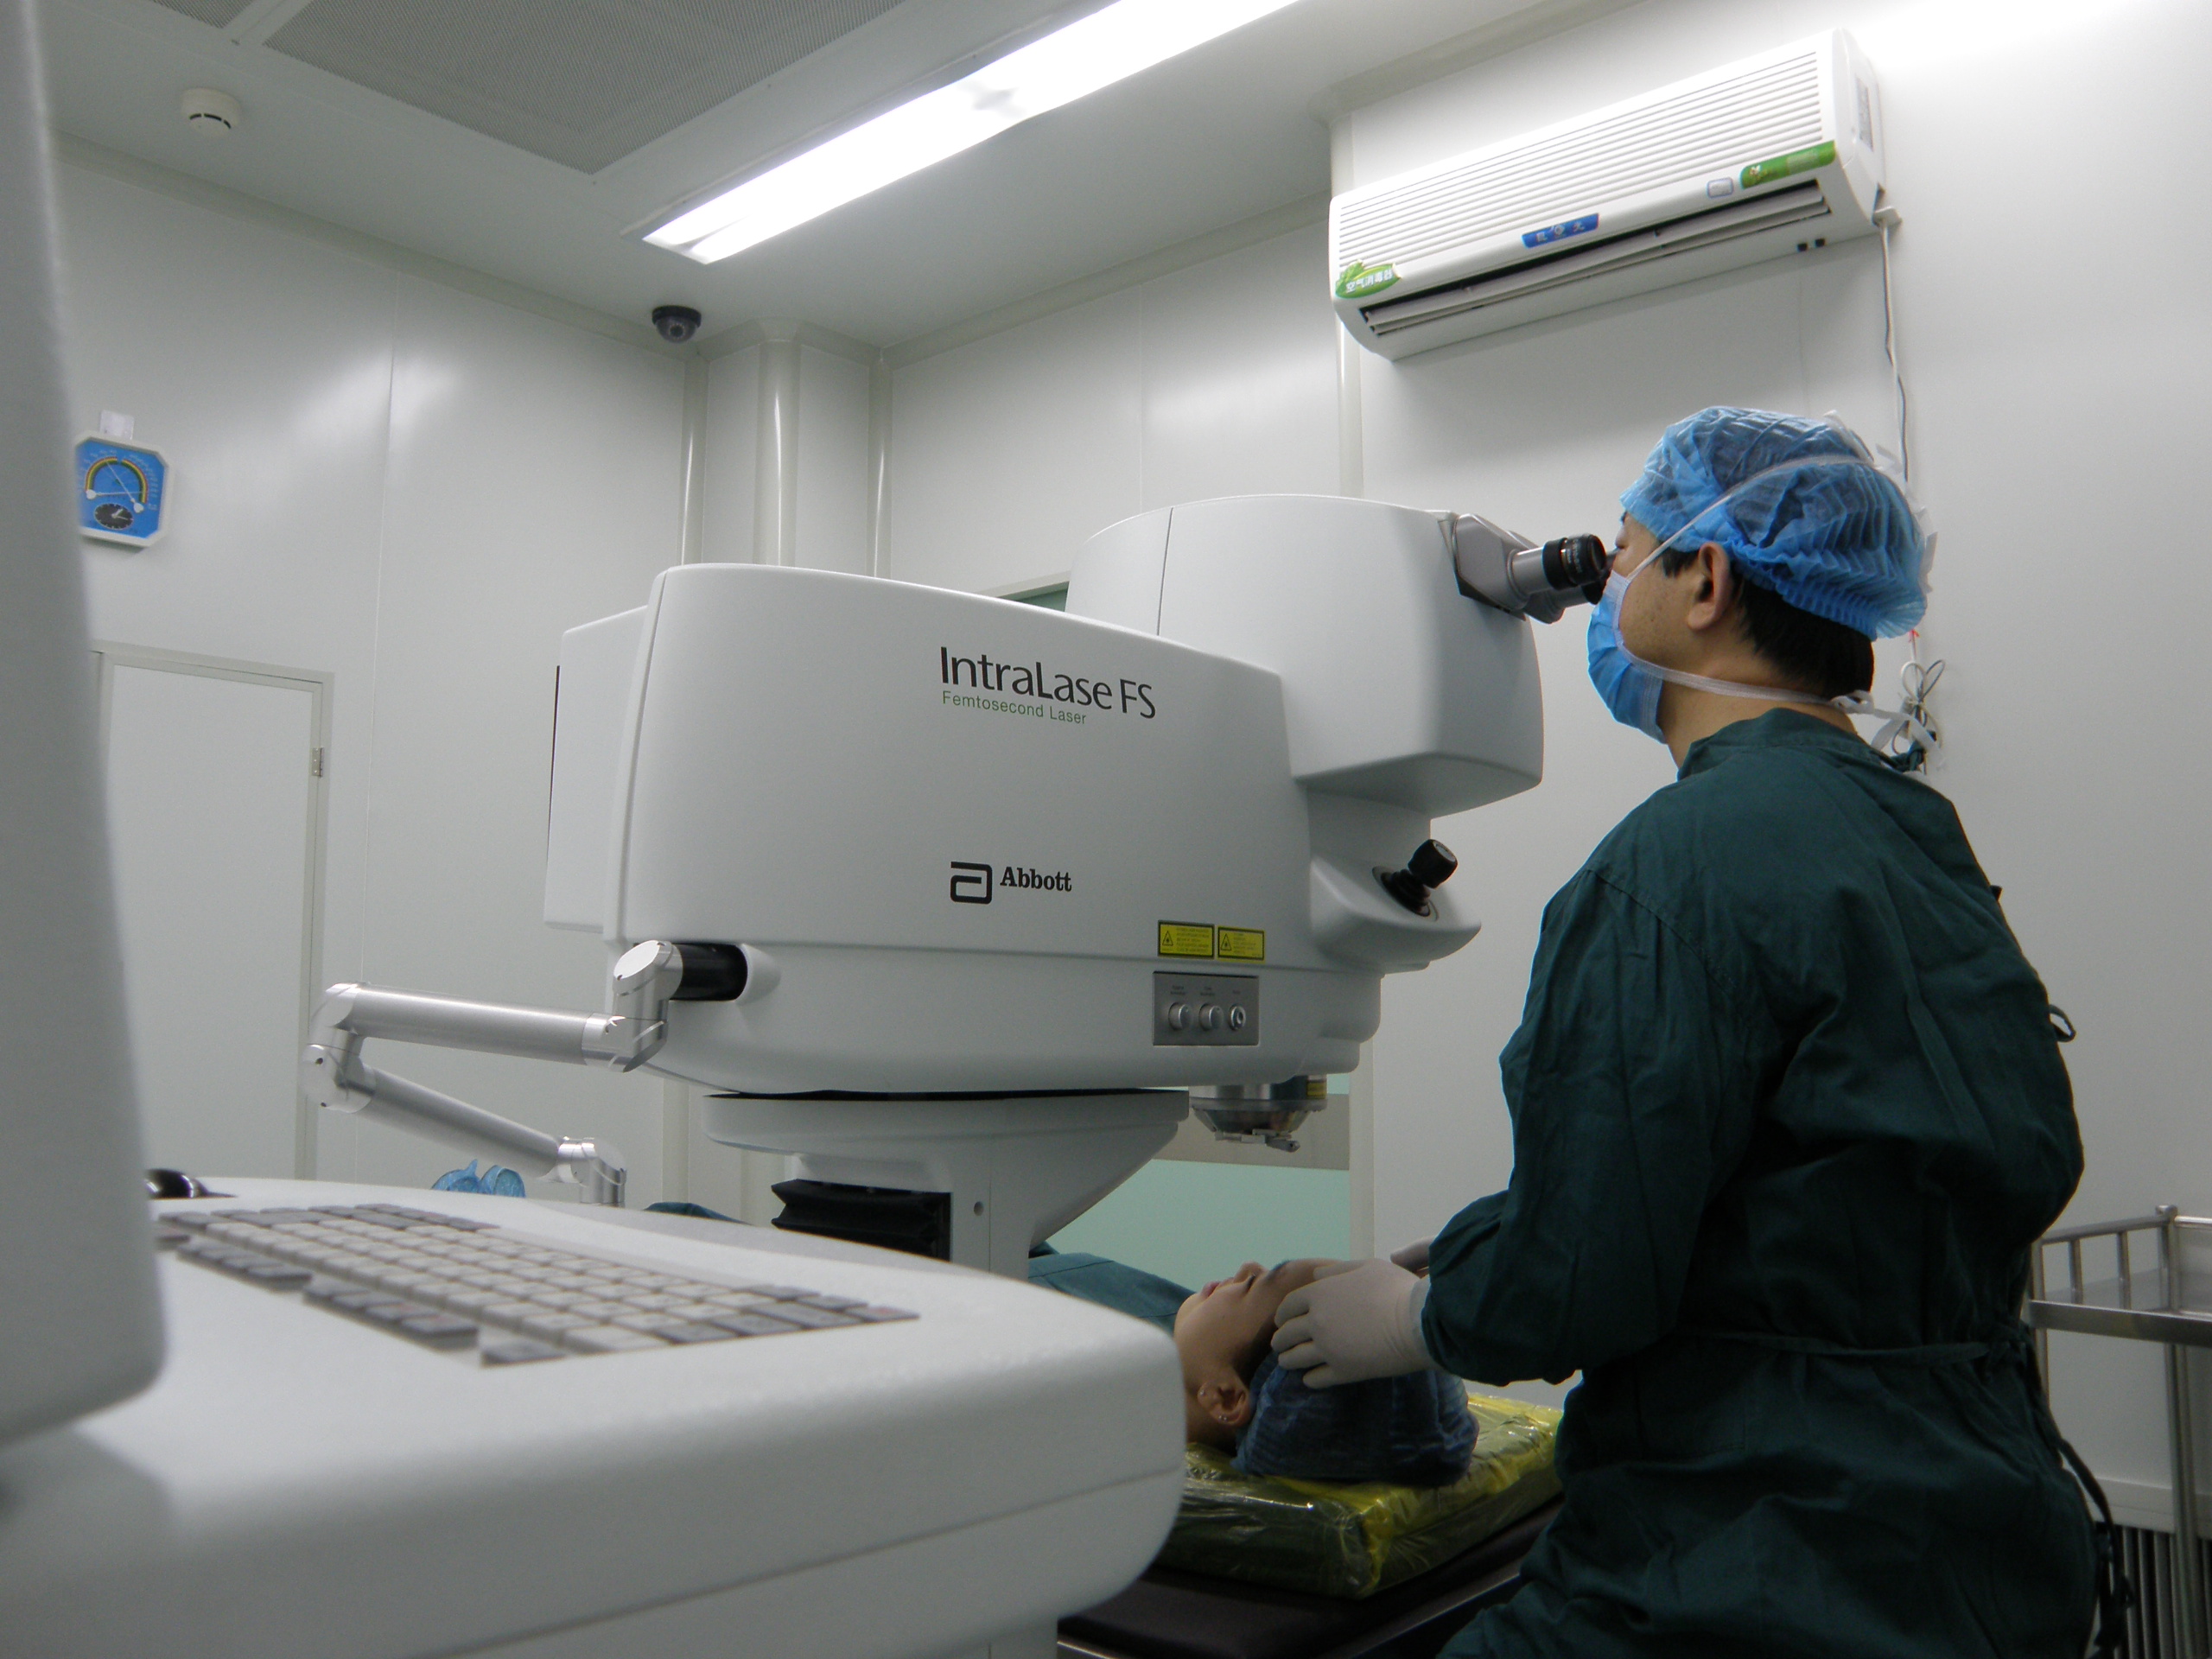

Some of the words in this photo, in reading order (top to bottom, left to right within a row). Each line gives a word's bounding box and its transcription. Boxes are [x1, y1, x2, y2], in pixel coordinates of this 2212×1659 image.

[940, 645, 1113, 710] IntraLase
[1120, 678, 1156, 719] FS
[942, 690, 1045, 718] Femtosecond
[1049, 705, 1087, 724] Laser
[999, 866, 1072, 893] Abbott
